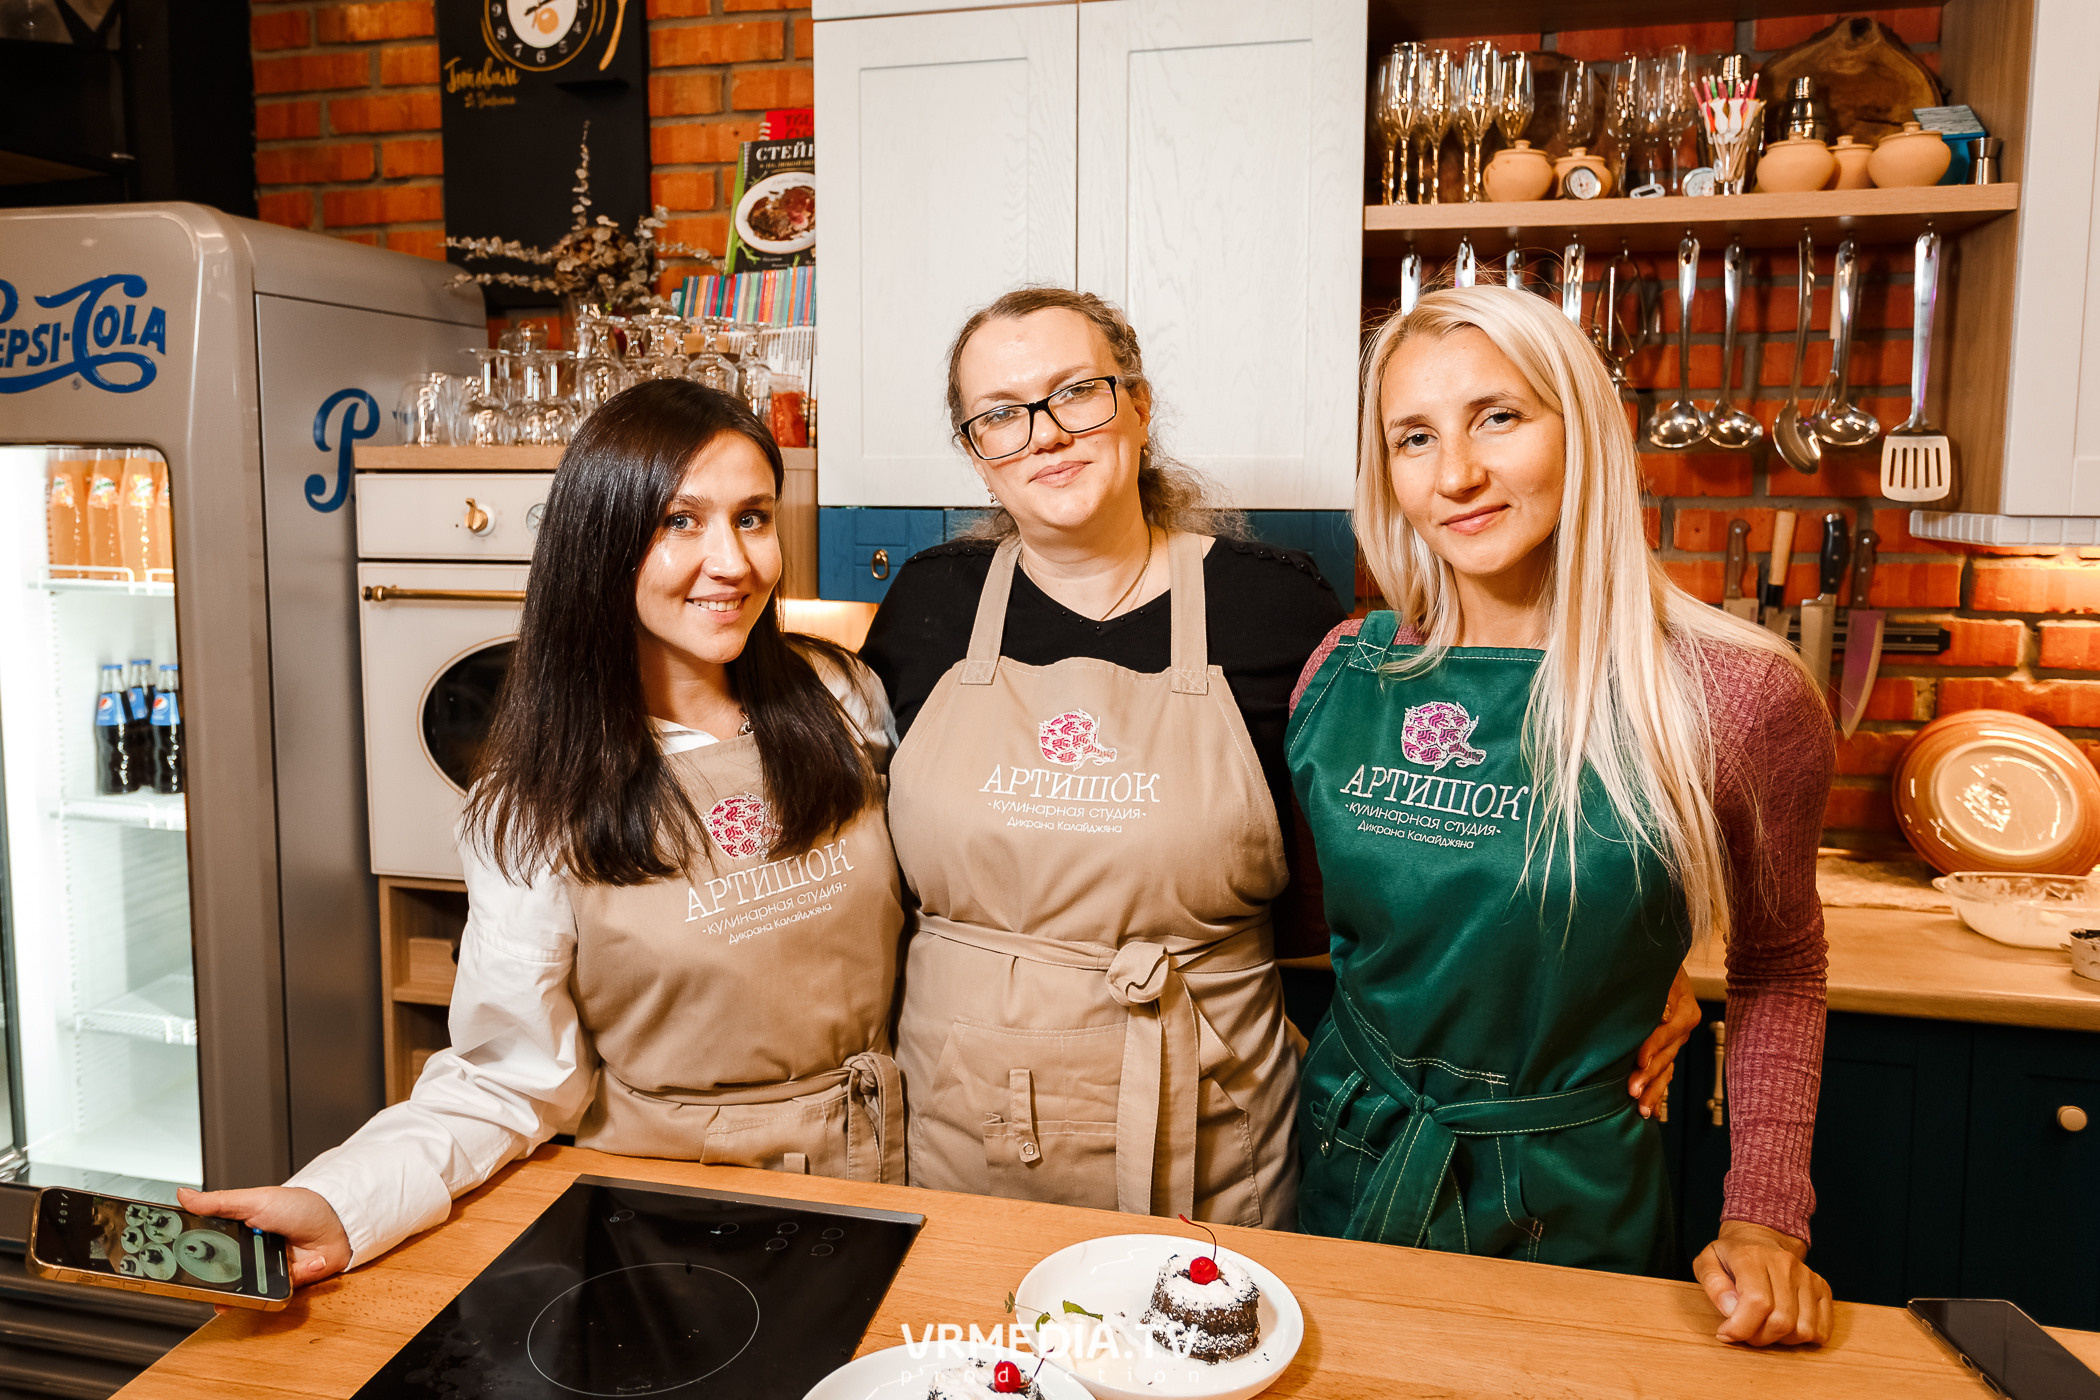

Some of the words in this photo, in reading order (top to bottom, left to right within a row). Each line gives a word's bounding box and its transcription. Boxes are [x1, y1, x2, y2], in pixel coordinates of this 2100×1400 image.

[492, 4, 502, 17] 9
[497, 26, 508, 41] 8
[513, 43, 523, 57] 7
[536, 50, 546, 64] 6
[978, 764, 1161, 803] АРТИШОК
[1339, 764, 1529, 821] АРТИШОК
[1088, 807, 1141, 822] студия
[1007, 816, 1055, 831] Дикрана
[1057, 821, 1122, 833] Калайджяна
[1444, 820, 1496, 837] студия
[1357, 819, 1406, 839] Дикрана
[1407, 830, 1475, 849] Калайджяна
[685, 838, 855, 922] АРТИШОК
[797, 882, 844, 906] студия
[728, 922, 774, 945] Дикрана
